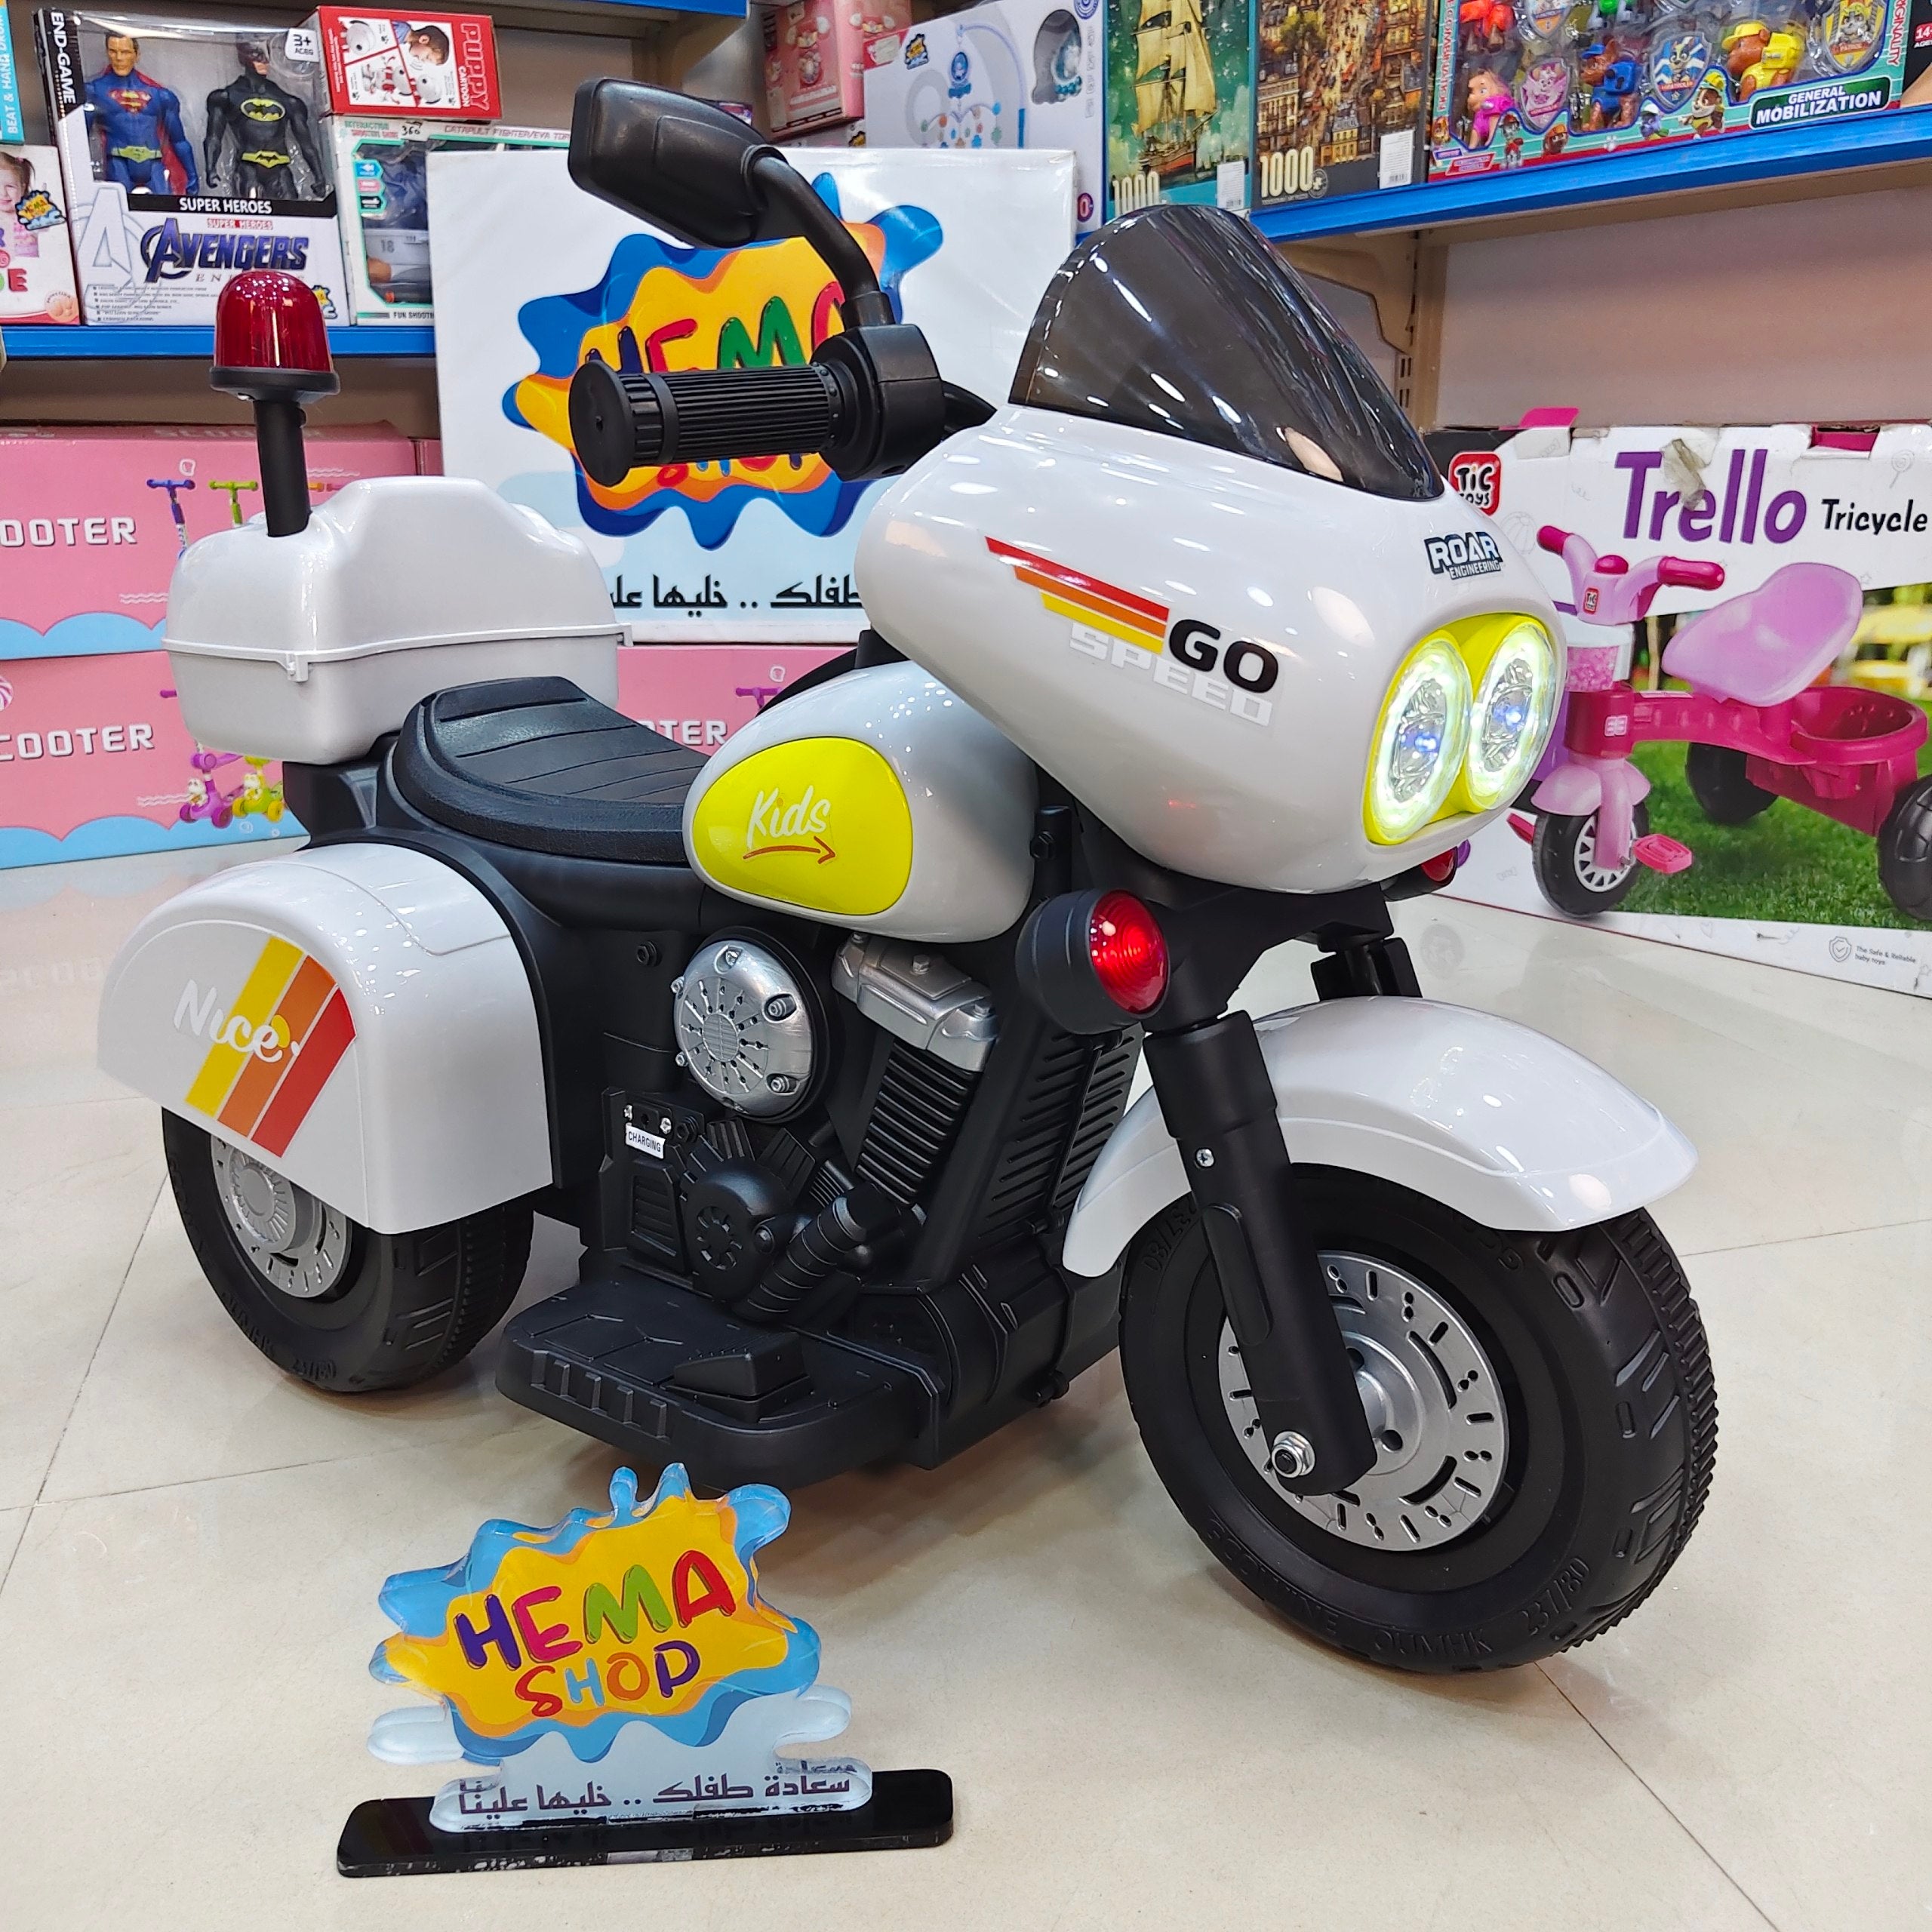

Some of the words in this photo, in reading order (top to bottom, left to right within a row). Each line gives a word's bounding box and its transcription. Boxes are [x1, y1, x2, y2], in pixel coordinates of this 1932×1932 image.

[51, 11, 76, 105] END-GAME
[460, 23, 490, 111] PUPPY
[458, 66, 471, 108] CARTOON
[1755, 90, 1882, 125] MOBILIZATION
[1788, 85, 1846, 105] GENERAL
[6, 105, 19, 134] BEAT
[1260, 146, 1314, 198] 1000
[179, 199, 222, 212] SUPER
[223, 199, 272, 214] HEROES
[140, 217, 309, 283] AVENGERS
[1614, 448, 1807, 545] Trello
[1821, 498, 1929, 535] Tricycle
[1424, 531, 1503, 574] ROAR
[1449, 560, 1501, 579] ENGINEERING
[1068, 621, 1274, 728] SPEED
[1168, 617, 1279, 695] GO
[746, 785, 831, 850] Kids
[628, 1131, 662, 1152] CHARGING
[454, 1549, 737, 1672] HEMA
[514, 1640, 702, 1718] SHOP
[458, 1786, 529, 1820] علينا
[536, 1780, 613, 1816] خليها
[652, 1771, 754, 1804] طفلك
[764, 1774, 851, 1798] سعادة
